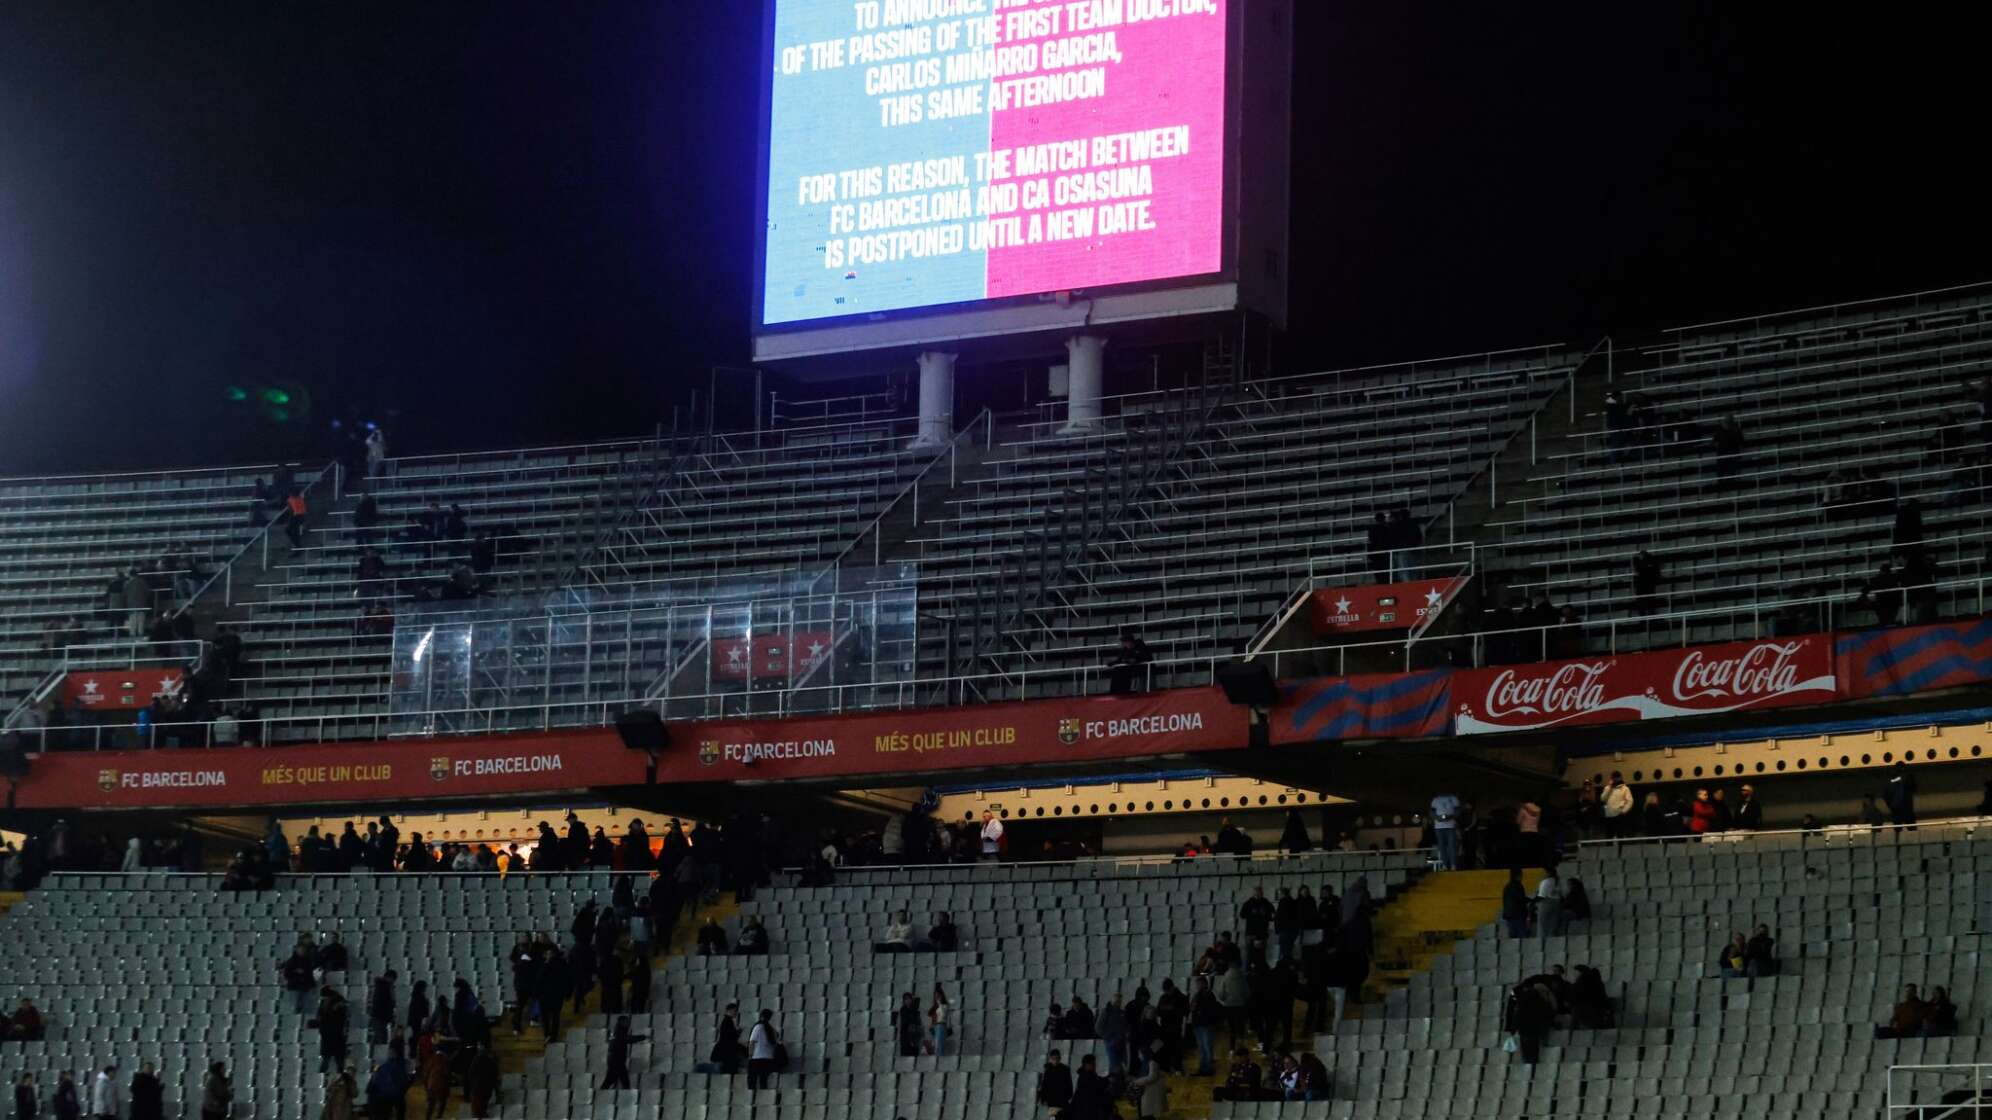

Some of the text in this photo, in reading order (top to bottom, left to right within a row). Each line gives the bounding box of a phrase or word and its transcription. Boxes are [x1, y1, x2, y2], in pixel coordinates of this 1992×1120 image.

[782, 45, 806, 75] OF
[810, 39, 845, 71] THE
[849, 26, 932, 65] PASSING
[936, 21, 962, 51] OF
[965, 14, 1002, 47] THE
[1005, 4, 1063, 42] FIRST
[1066, 0, 1123, 33] TEAM
[854, 1, 879, 31] TO
[865, 31, 1122, 96] CARLOS MIÑARRO GARCIA,
[879, 67, 1105, 127] THIS SAME AFTERNOON
[799, 125, 1189, 205] FOR THIS REASON, THE MATCH BETWEEN
[830, 165, 1153, 235] FC BARCELONA AND CA OSASUNA
[825, 200, 1157, 269] IS POSTPONED UNTIL A NEW DATE.
[1485, 661, 1609, 717] Coca-Cola
[1672, 639, 1803, 701] Coca-Cola
[724, 744, 741, 760] FC
[875, 727, 1016, 753] MÉS QUE UN CLUB
[1085, 712, 1203, 739] FC BARCELONA
[122, 771, 226, 788] FC BARCELONA
[262, 764, 391, 786] MÉS QUE UN CLUB
[454, 754, 562, 776] FC BARCELONA
